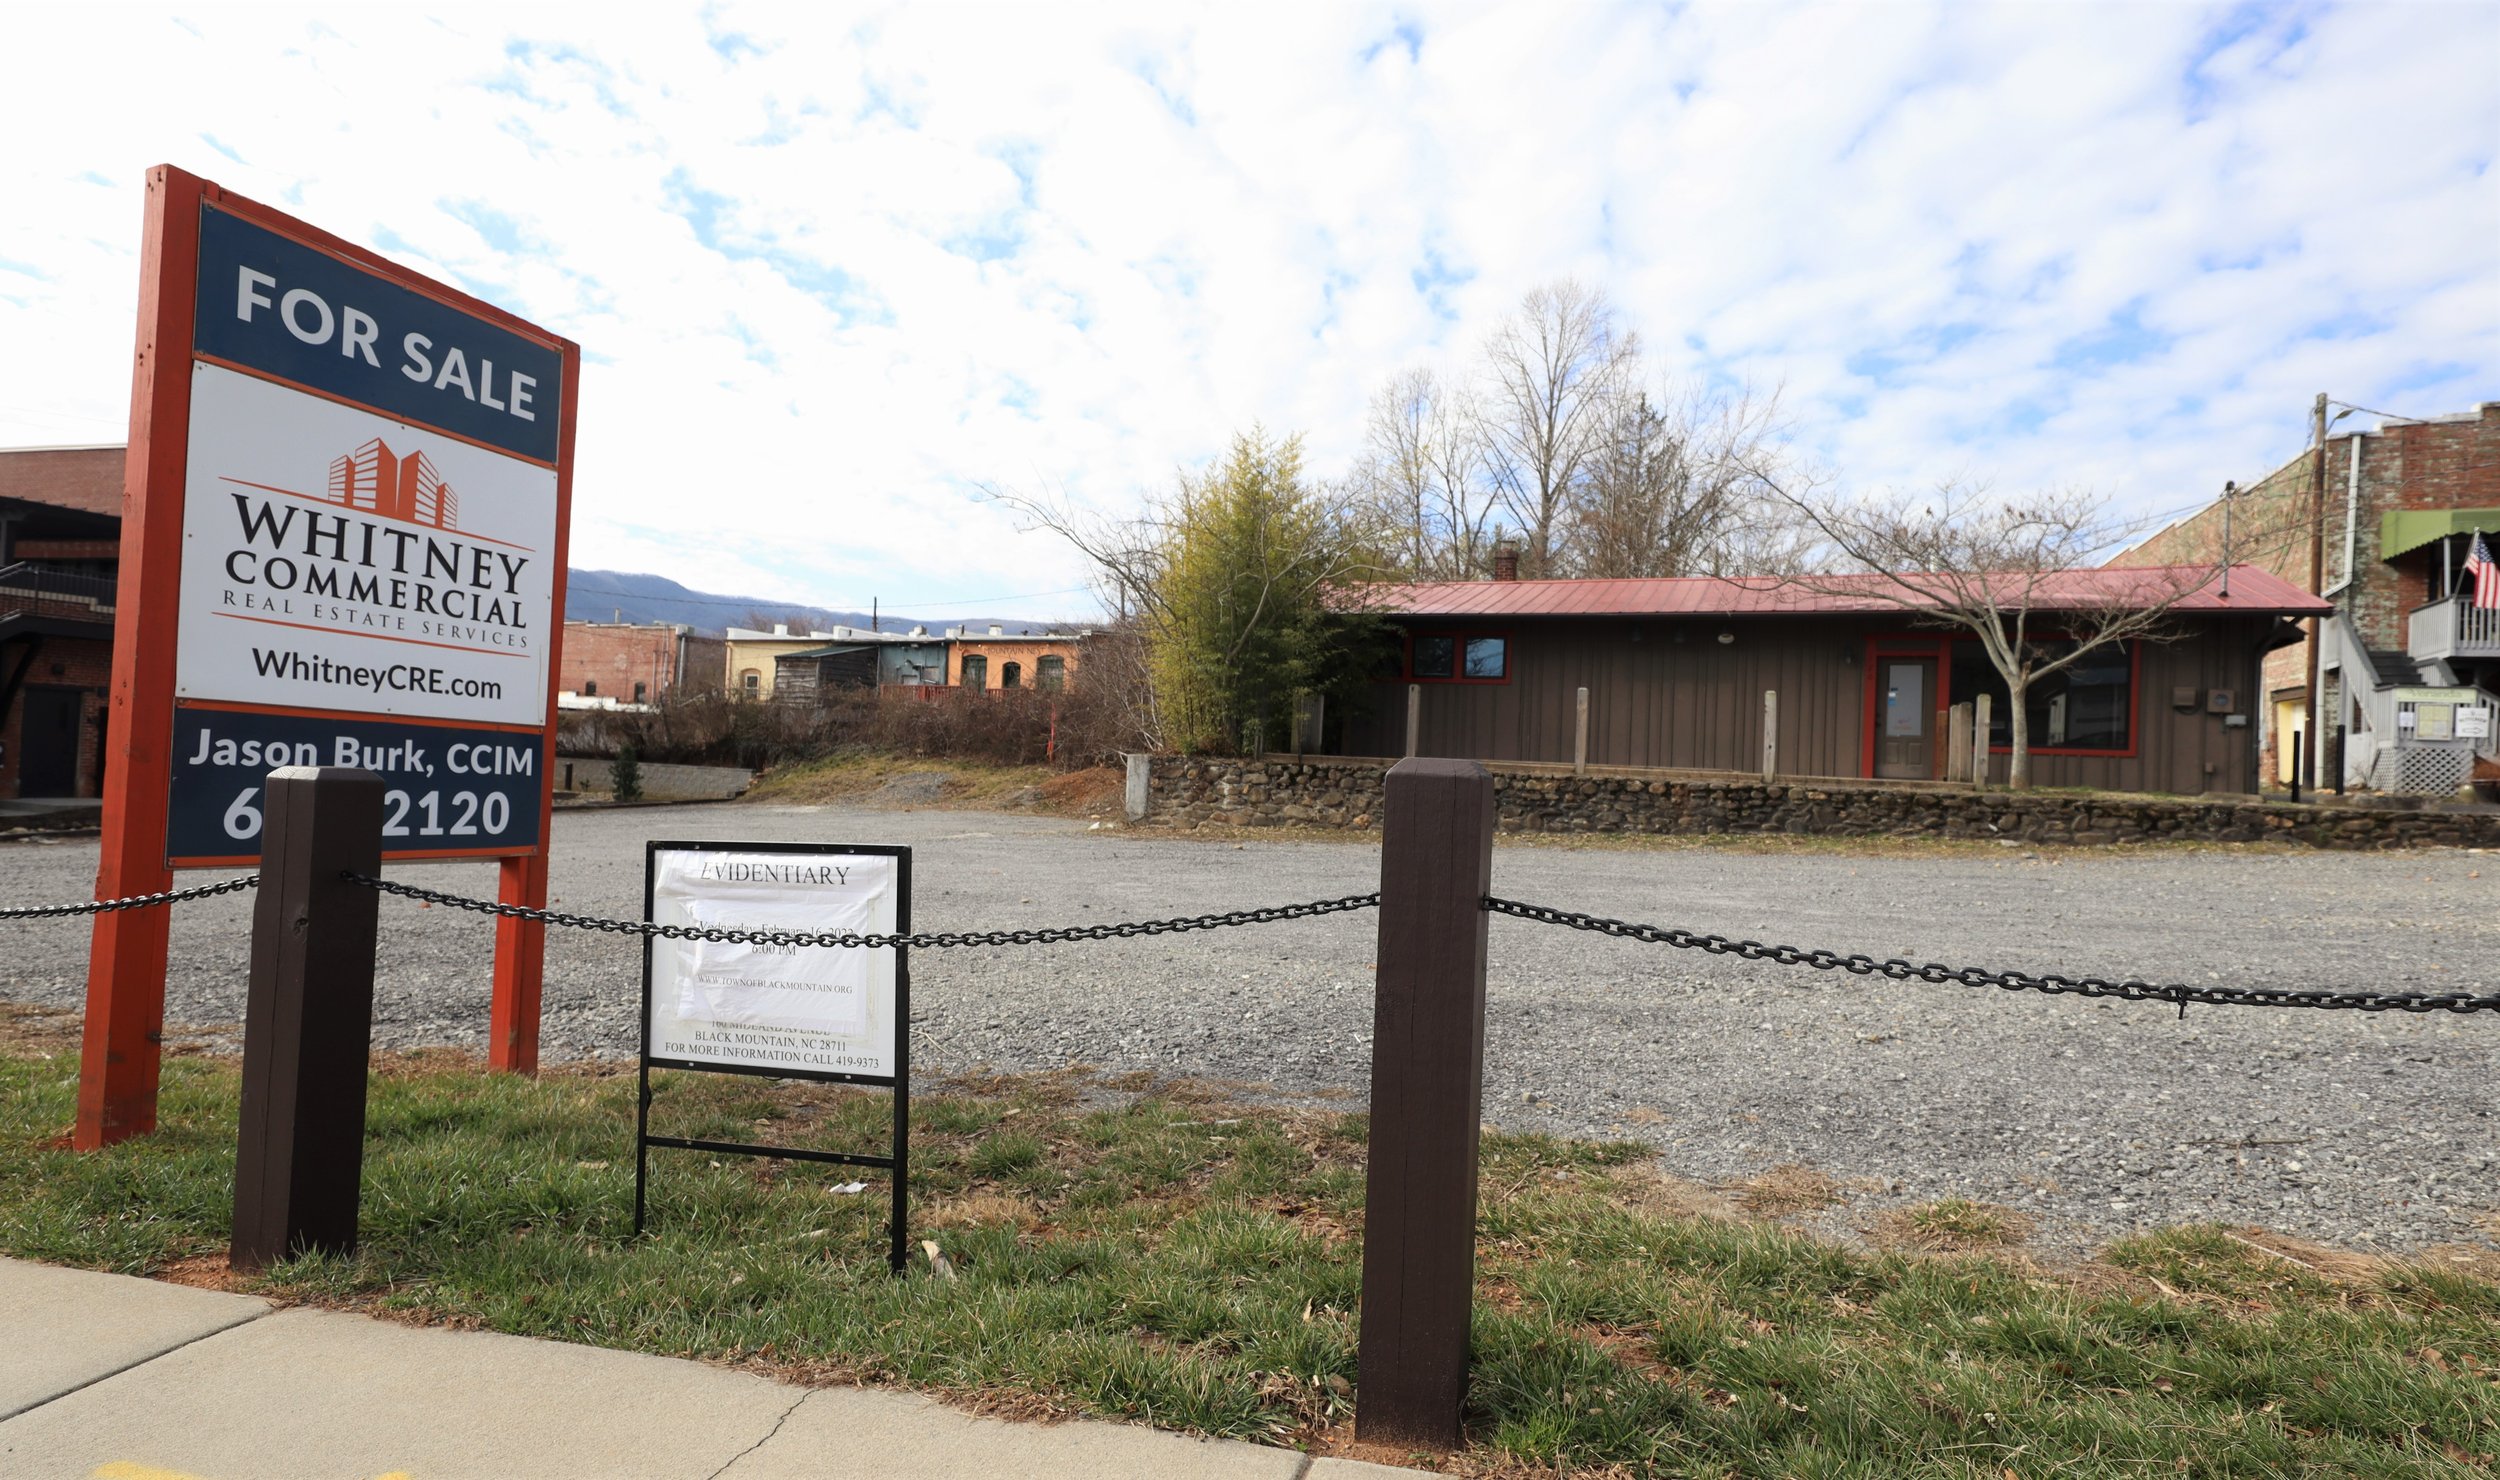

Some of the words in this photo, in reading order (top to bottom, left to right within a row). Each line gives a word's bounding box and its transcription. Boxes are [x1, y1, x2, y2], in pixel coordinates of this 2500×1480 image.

[236, 265, 381, 369] FOR
[401, 331, 537, 422] SALE
[231, 493, 529, 594] WHITNEY
[225, 550, 528, 629] COMMERCIAL
[223, 589, 294, 615] REAL
[313, 604, 405, 631] ESTATE
[422, 620, 529, 648] SERVICES
[252, 647, 502, 700] WhitneyCRE.com
[188, 728, 318, 768] Jason
[334, 736, 435, 778] Burk,
[446, 743, 534, 777] CCIM
[700, 862, 850, 886] EVIDENTIARY
[752, 943, 776, 955] 6:00
[778, 945, 796, 956] PM
[697, 974, 853, 994] WWW.TOWNOFBLACKMOUNTAIN.ORG
[665, 1042, 686, 1053] FOR
[688, 1043, 720, 1056] MORE
[722, 1047, 800, 1062] INFORMATION
[803, 1053, 834, 1065] CALL
[835, 1054, 879, 1069] 419-9373
[695, 1030, 732, 1043] BLACK
[735, 1033, 799, 1049] MOUNTAIN,
[801, 1038, 817, 1050] NC
[819, 1039, 846, 1052] 28711
